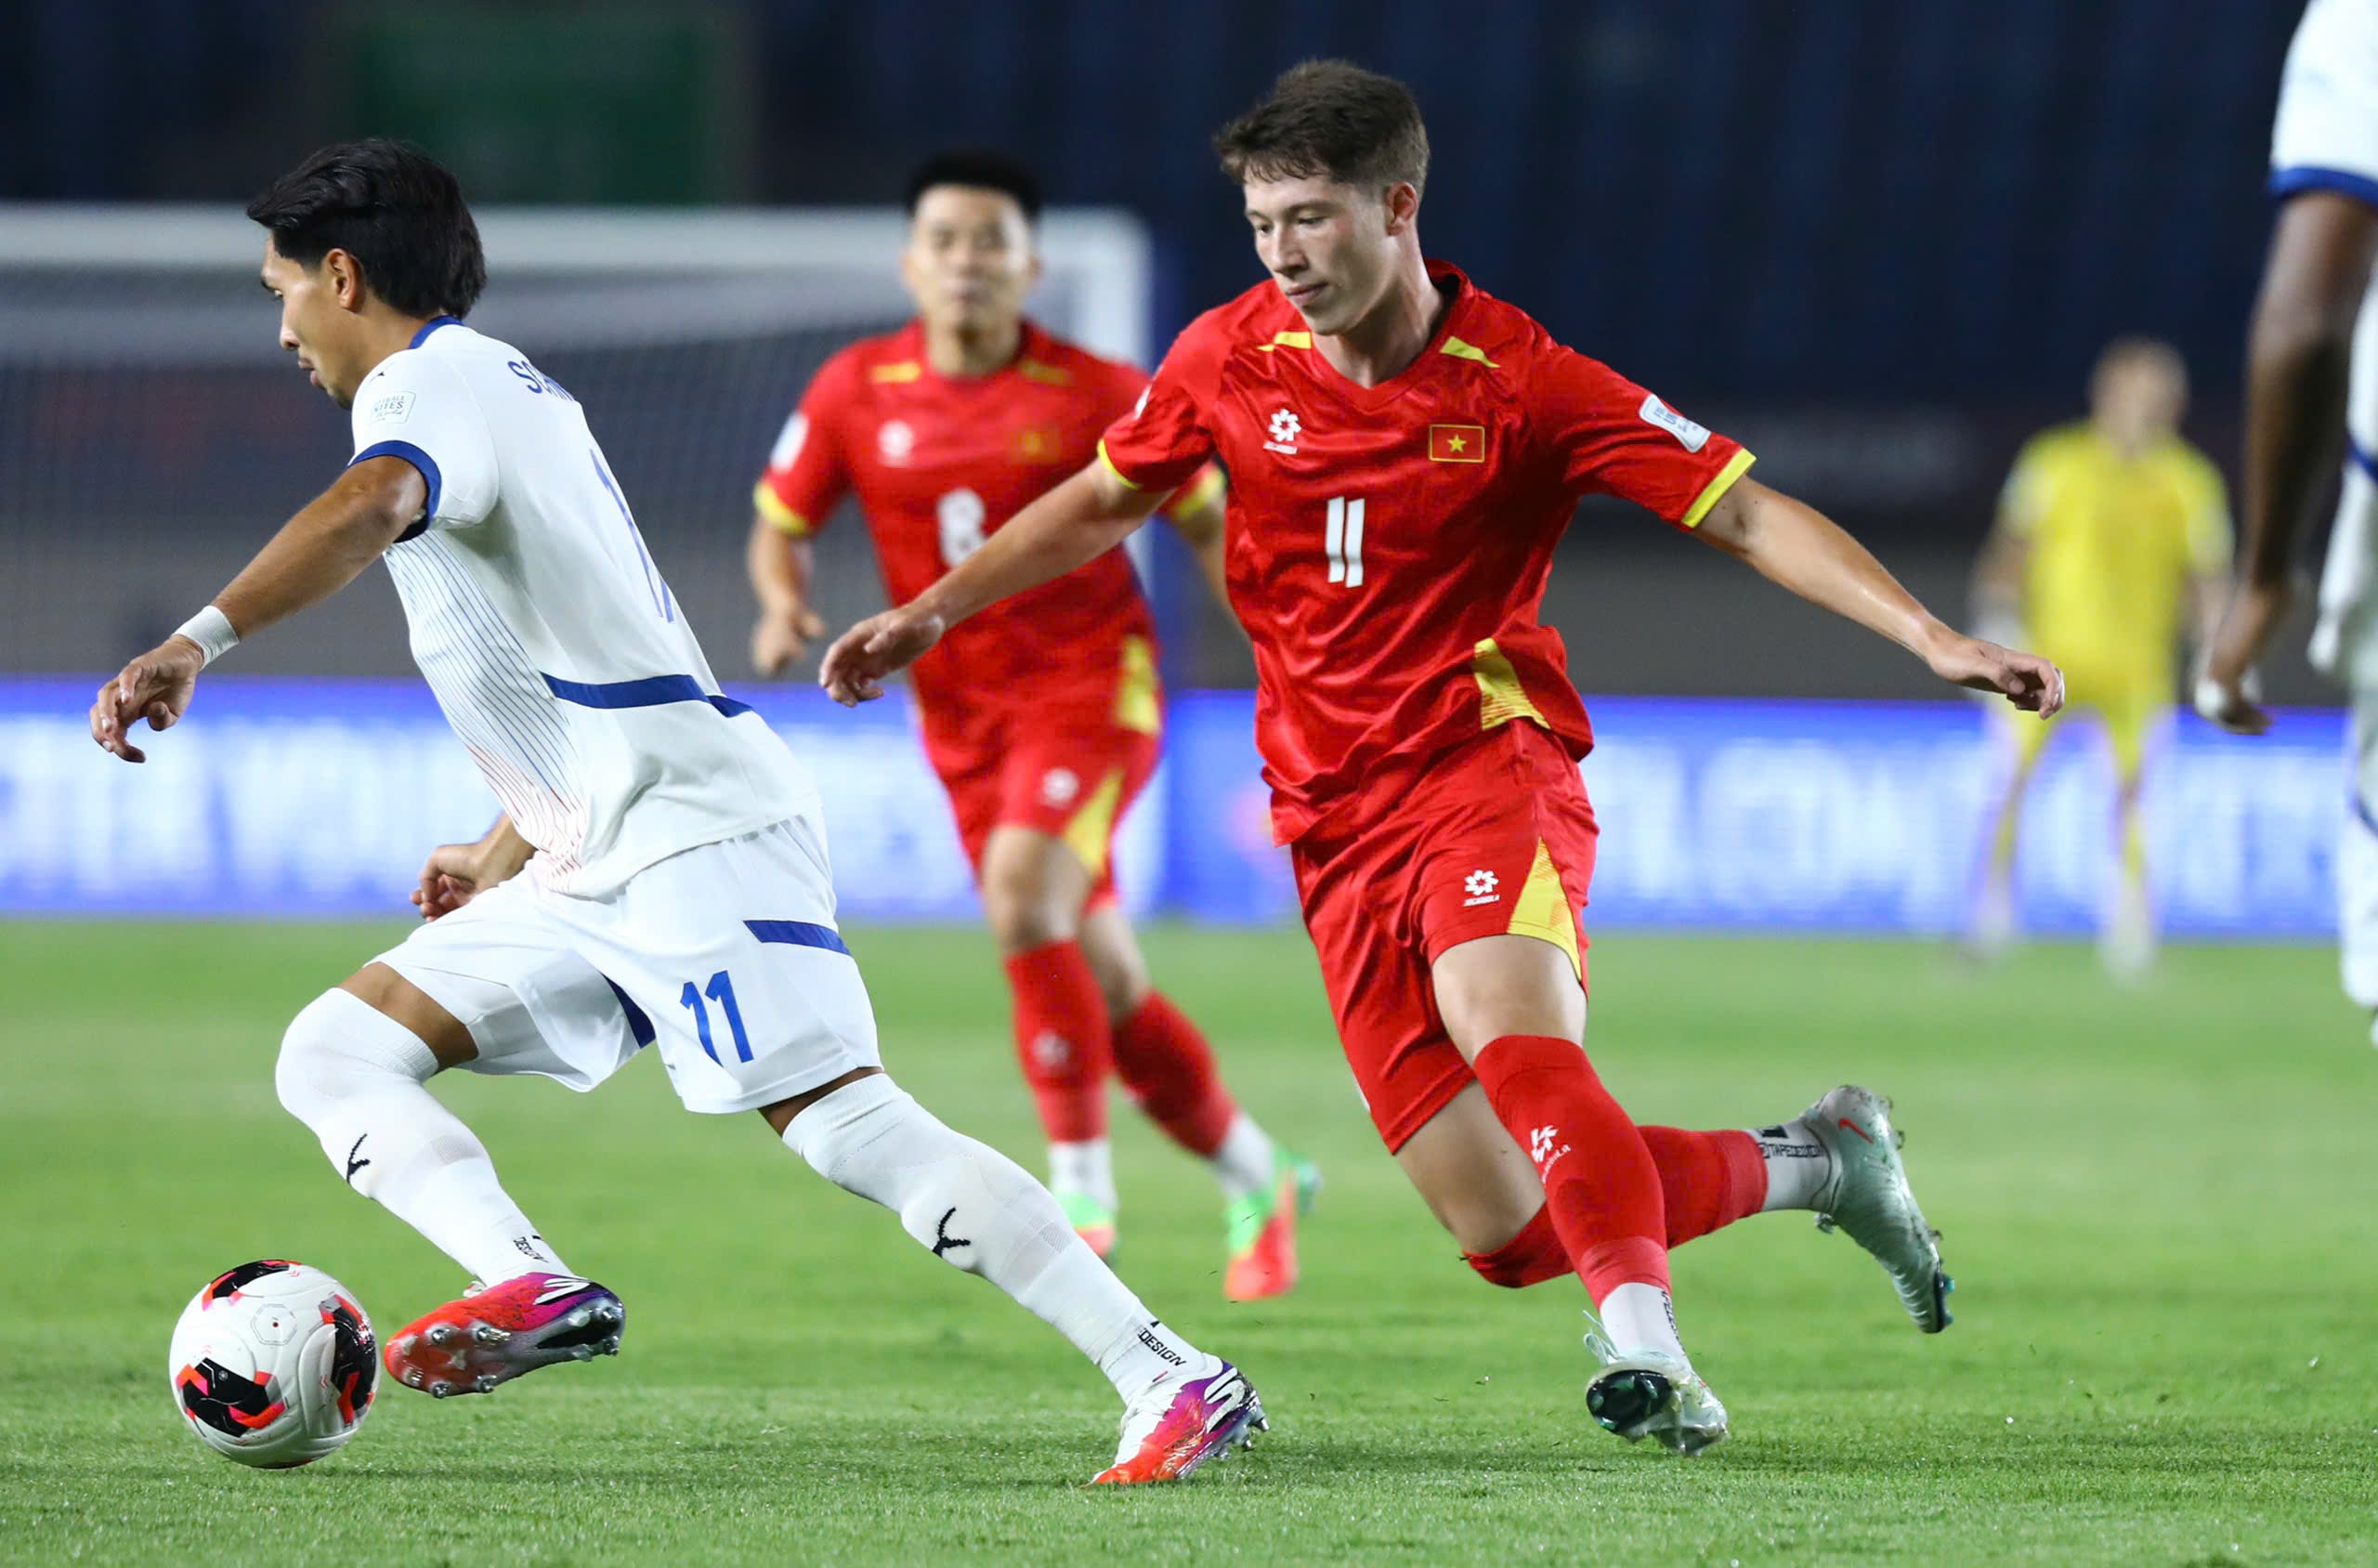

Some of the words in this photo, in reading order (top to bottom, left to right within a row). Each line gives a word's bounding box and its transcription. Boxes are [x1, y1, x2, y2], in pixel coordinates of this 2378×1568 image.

[1326, 496, 1365, 588] 11
[680, 970, 754, 1068] 11
[1138, 1328, 1186, 1366] DESIGN
